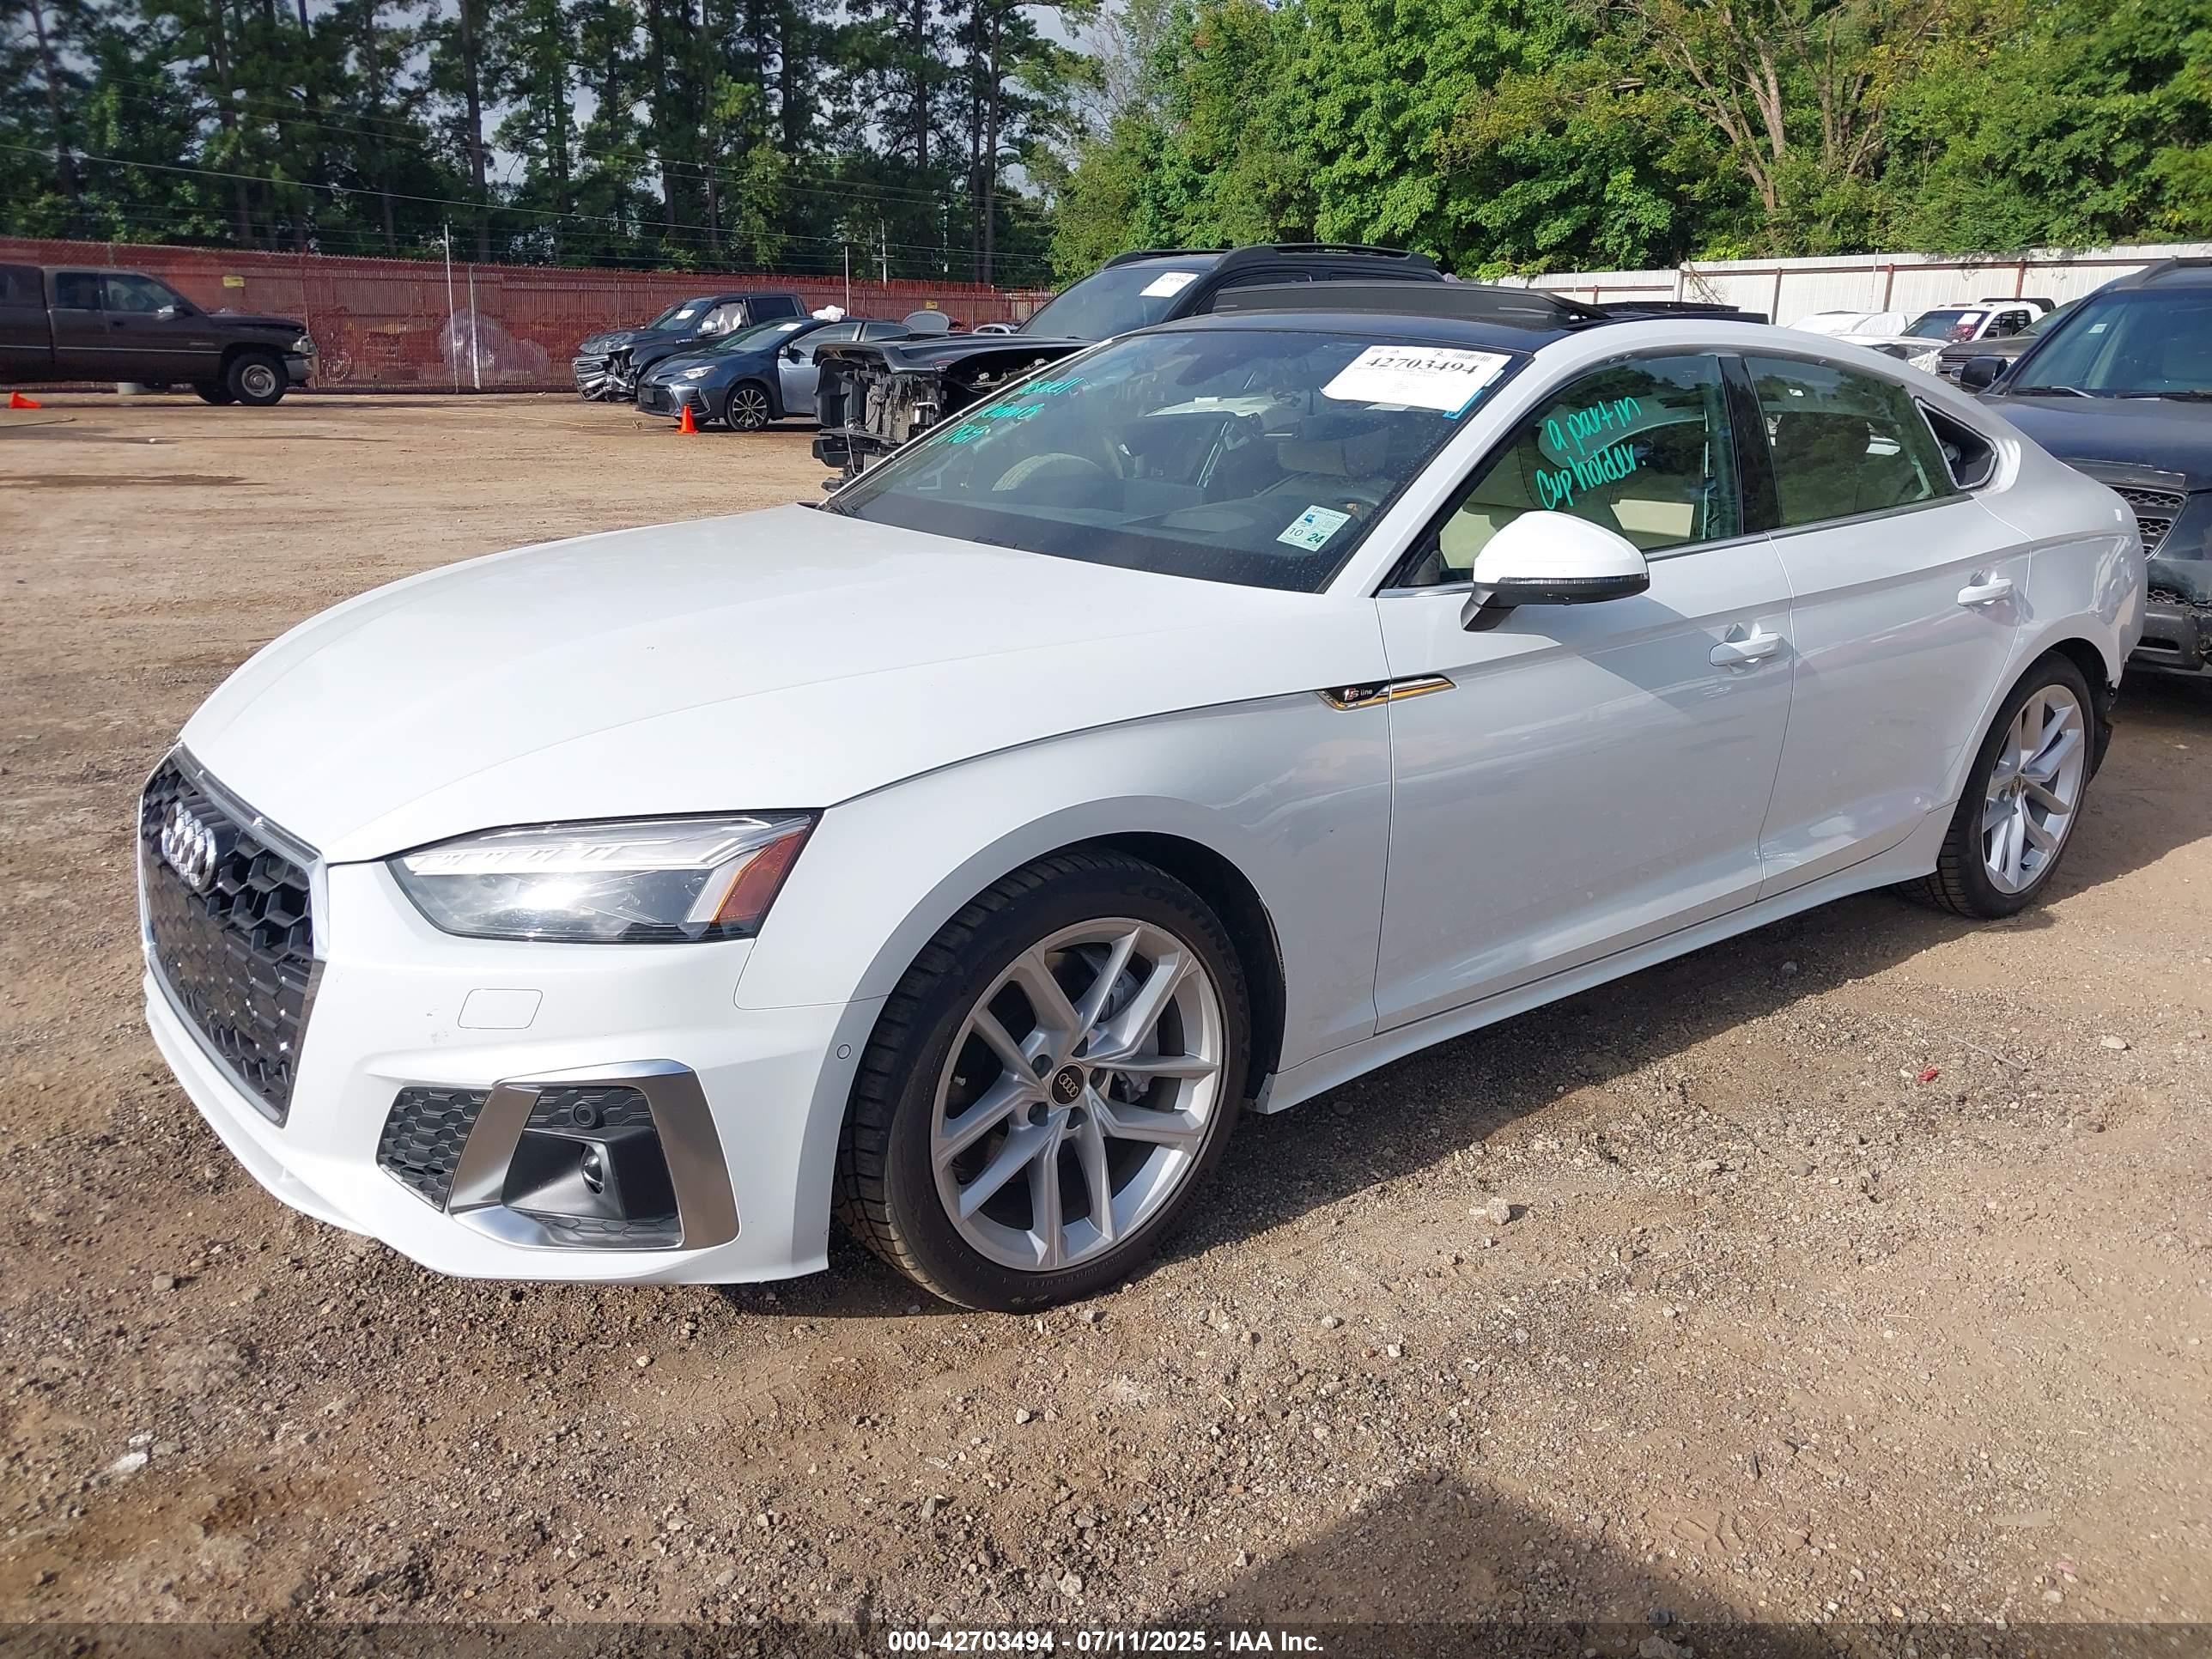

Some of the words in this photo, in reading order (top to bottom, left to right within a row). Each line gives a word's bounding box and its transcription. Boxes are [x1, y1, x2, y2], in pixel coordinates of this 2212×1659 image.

[1366, 356, 1480, 374] 42703494
[1548, 419, 1570, 451] a
[1567, 400, 1613, 456] part
[1613, 397, 1642, 428] in
[1289, 527, 1304, 537] 10
[1306, 532, 1326, 544] 24
